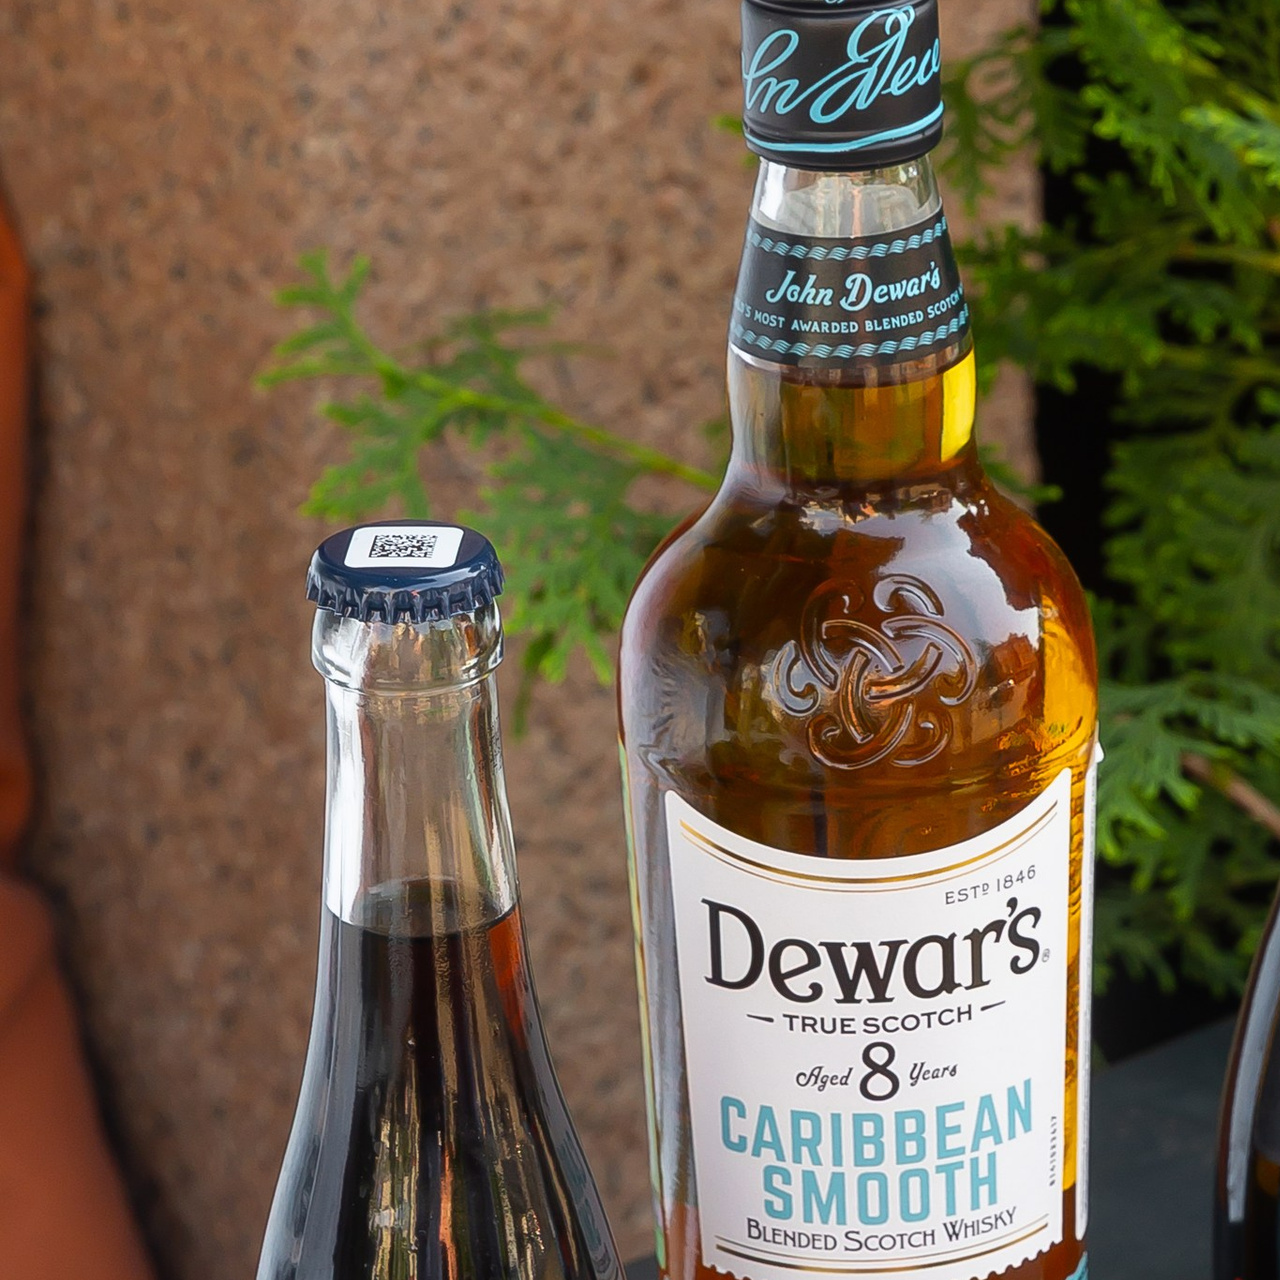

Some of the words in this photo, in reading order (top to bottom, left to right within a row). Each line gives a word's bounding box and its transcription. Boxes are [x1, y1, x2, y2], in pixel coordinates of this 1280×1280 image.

[765, 270, 833, 306] John
[839, 261, 942, 312] Dewar's
[753, 310, 785, 329] MOST
[790, 320, 859, 334] AWARDED
[864, 310, 924, 332] BLENDED
[927, 293, 960, 319] SCOTCH
[996, 864, 1037, 892] 1846
[700, 896, 1042, 1005] Dewar's
[782, 1013, 857, 1034] TRUE
[862, 1004, 973, 1034] SCOTCH
[795, 1065, 854, 1092] Aged
[859, 1041, 901, 1101] 8
[909, 1060, 959, 1087] Years
[719, 1077, 1033, 1168] CARIBBEAN
[762, 1151, 998, 1226] SMOOTH
[746, 1216, 838, 1252] BLENDED
[843, 1229, 937, 1252] SCOTCH
[942, 1206, 1018, 1242] WHISKY
